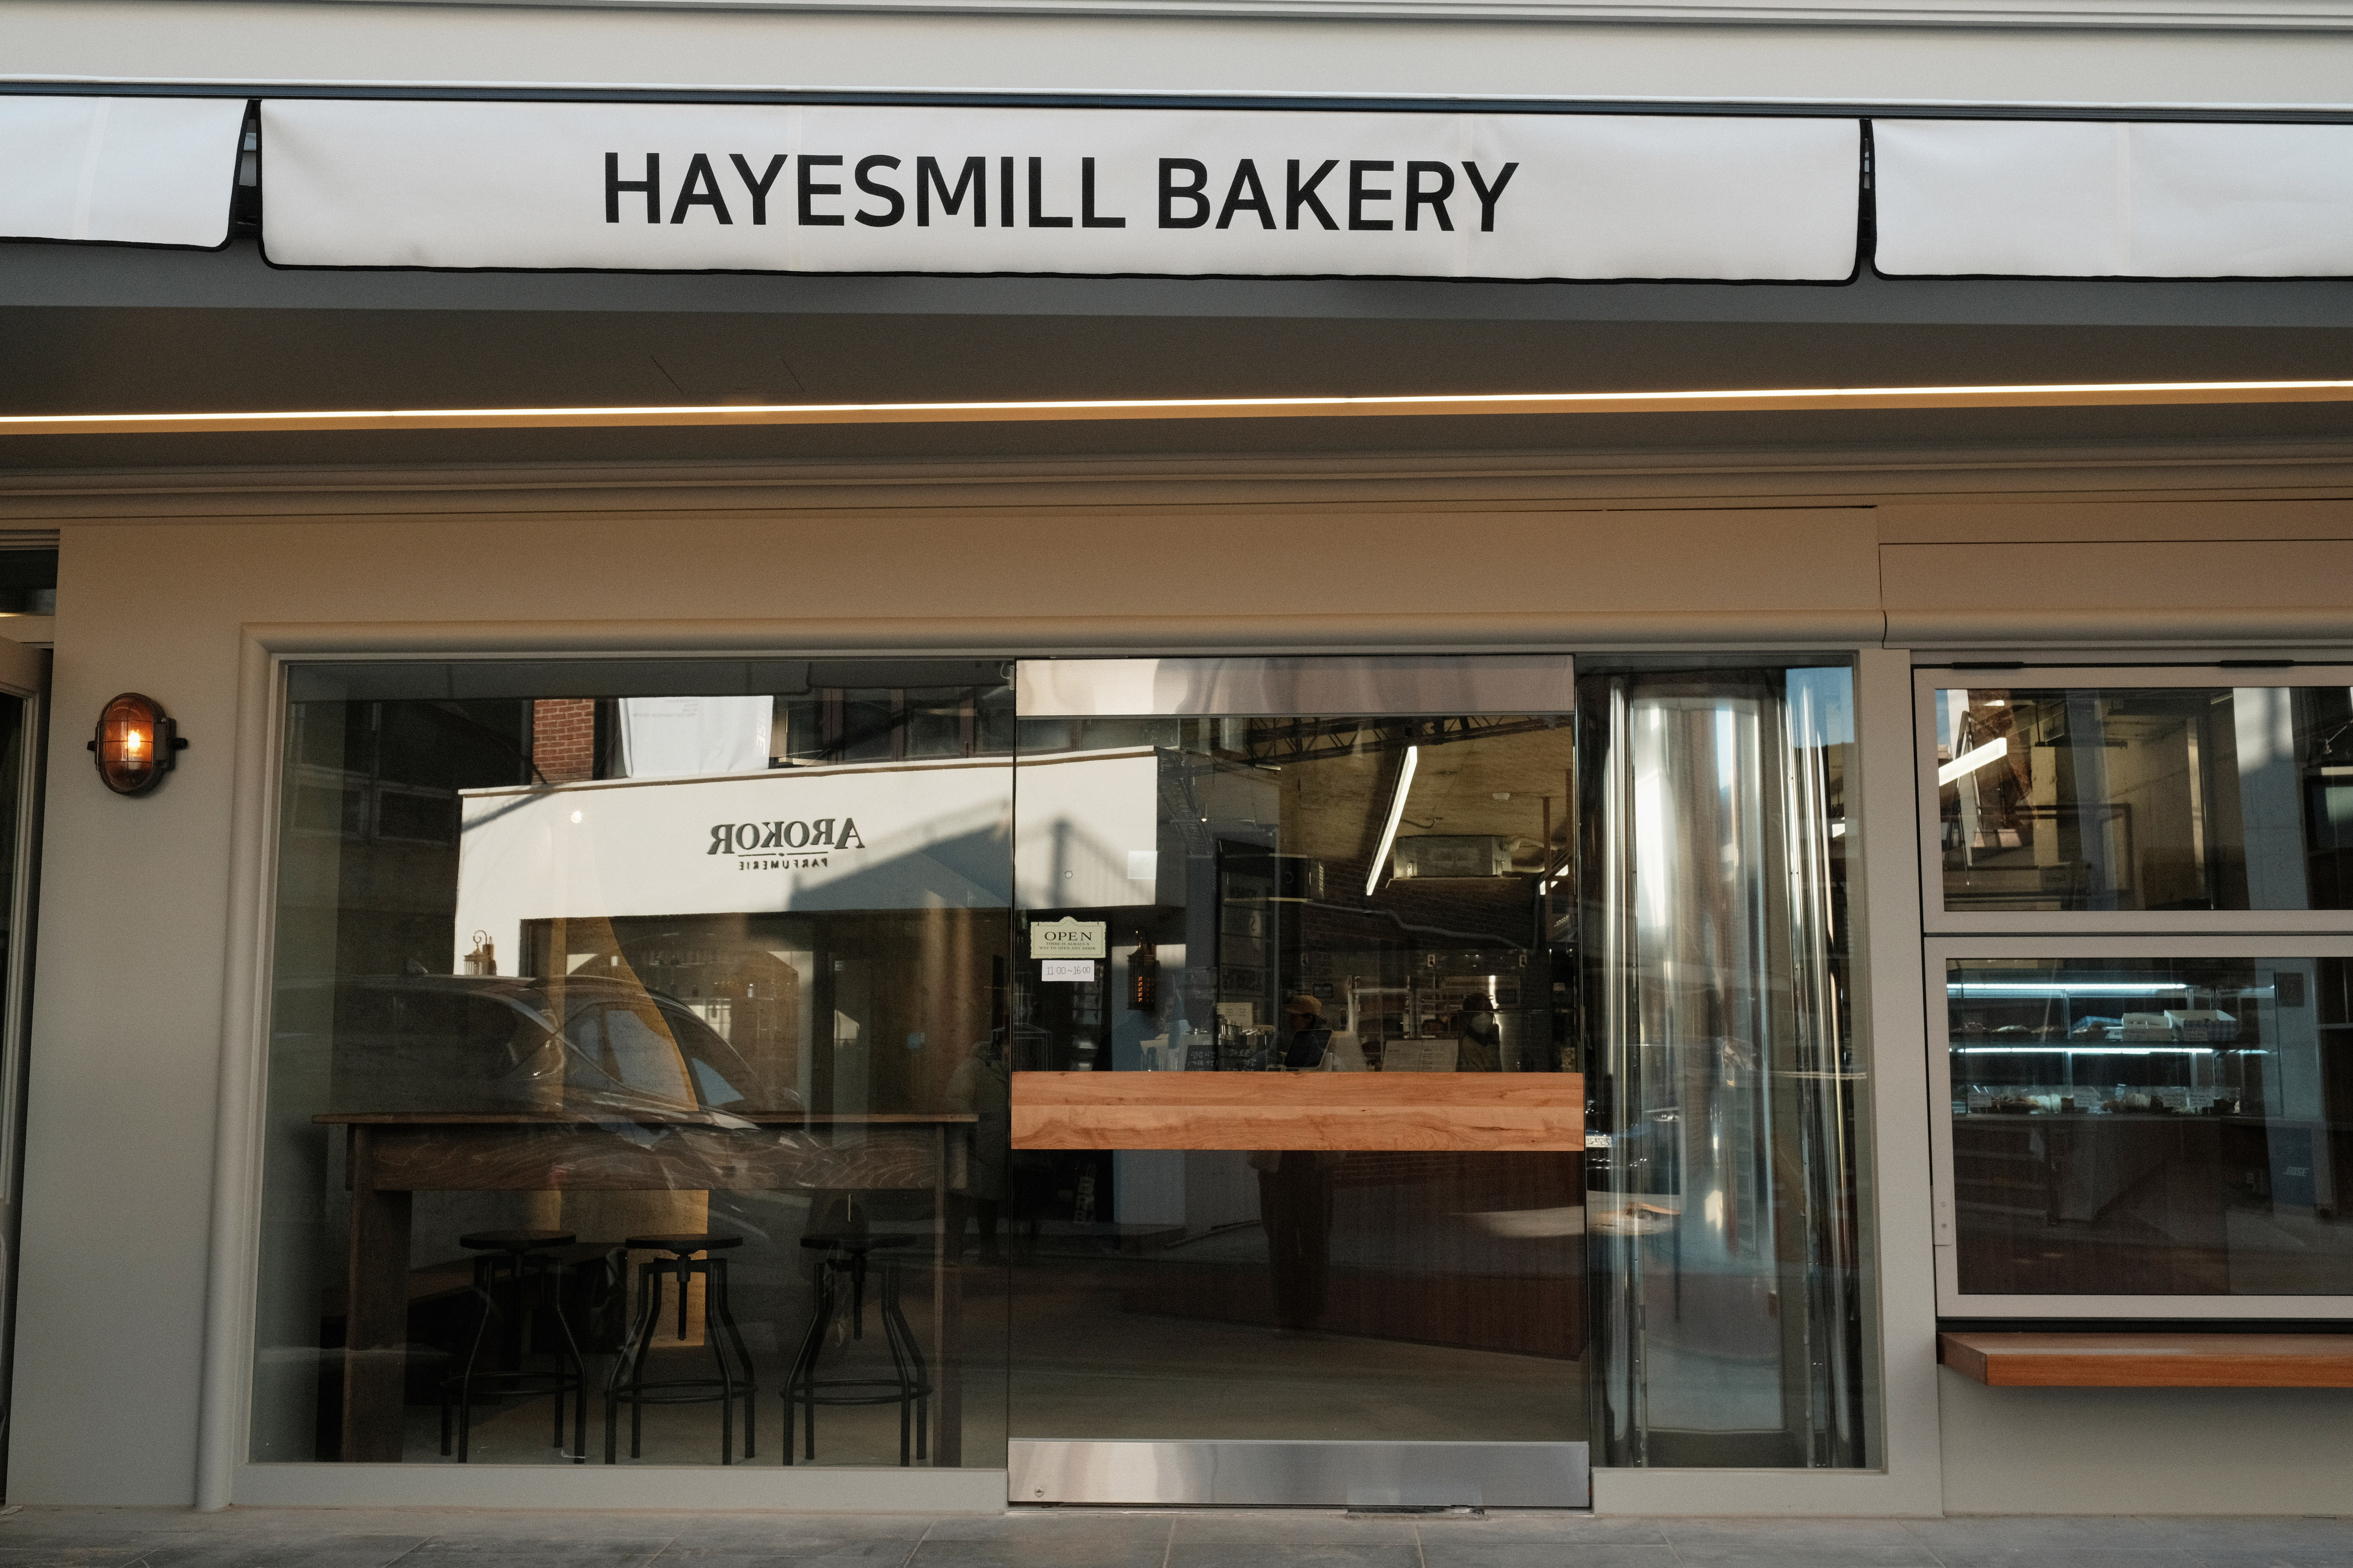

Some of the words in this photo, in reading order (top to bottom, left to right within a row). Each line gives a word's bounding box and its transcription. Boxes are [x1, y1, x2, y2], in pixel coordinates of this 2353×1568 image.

[605, 152, 1126, 228] HAYESMILL
[1159, 158, 1519, 232] BAKERY
[1044, 931, 1092, 941] OPEN
[2283, 1166, 2310, 1177] BOSE
